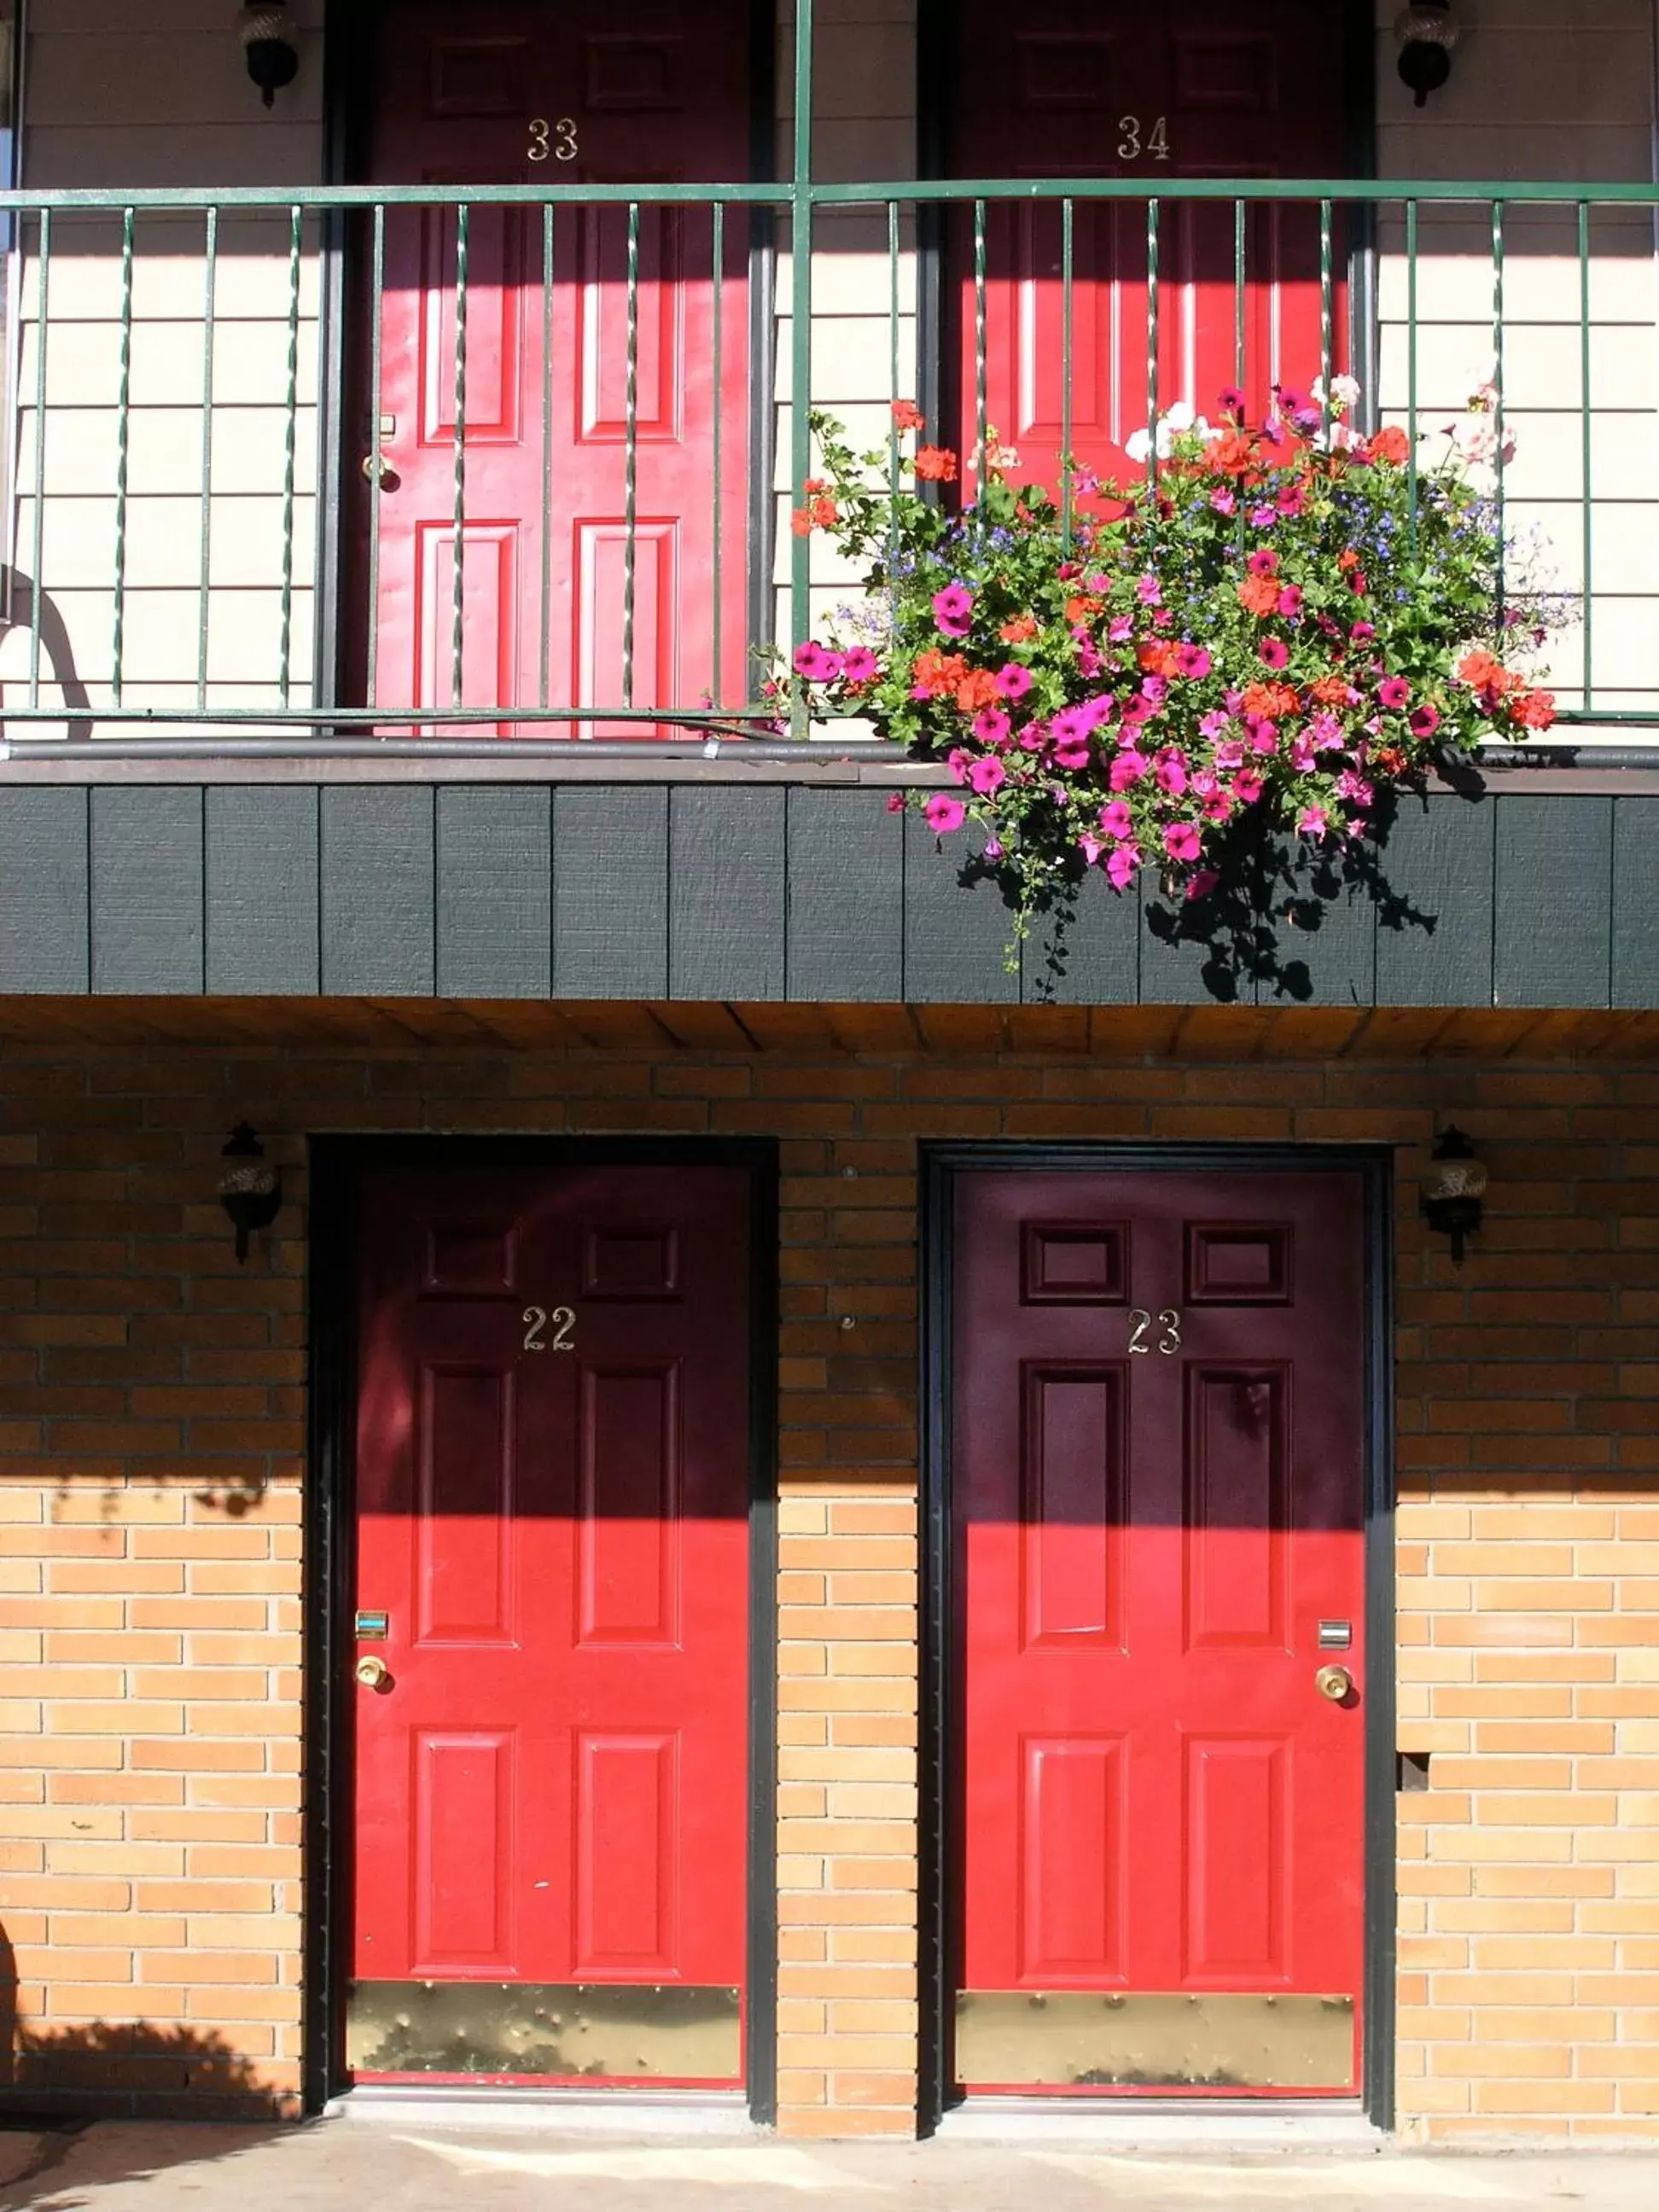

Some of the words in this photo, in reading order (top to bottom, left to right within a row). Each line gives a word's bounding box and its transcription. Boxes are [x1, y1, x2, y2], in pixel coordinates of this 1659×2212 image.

[527, 118, 577, 160] 33
[1117, 116, 1170, 160] 34
[522, 1307, 575, 1351] 22
[1128, 1309, 1180, 1354] 23
